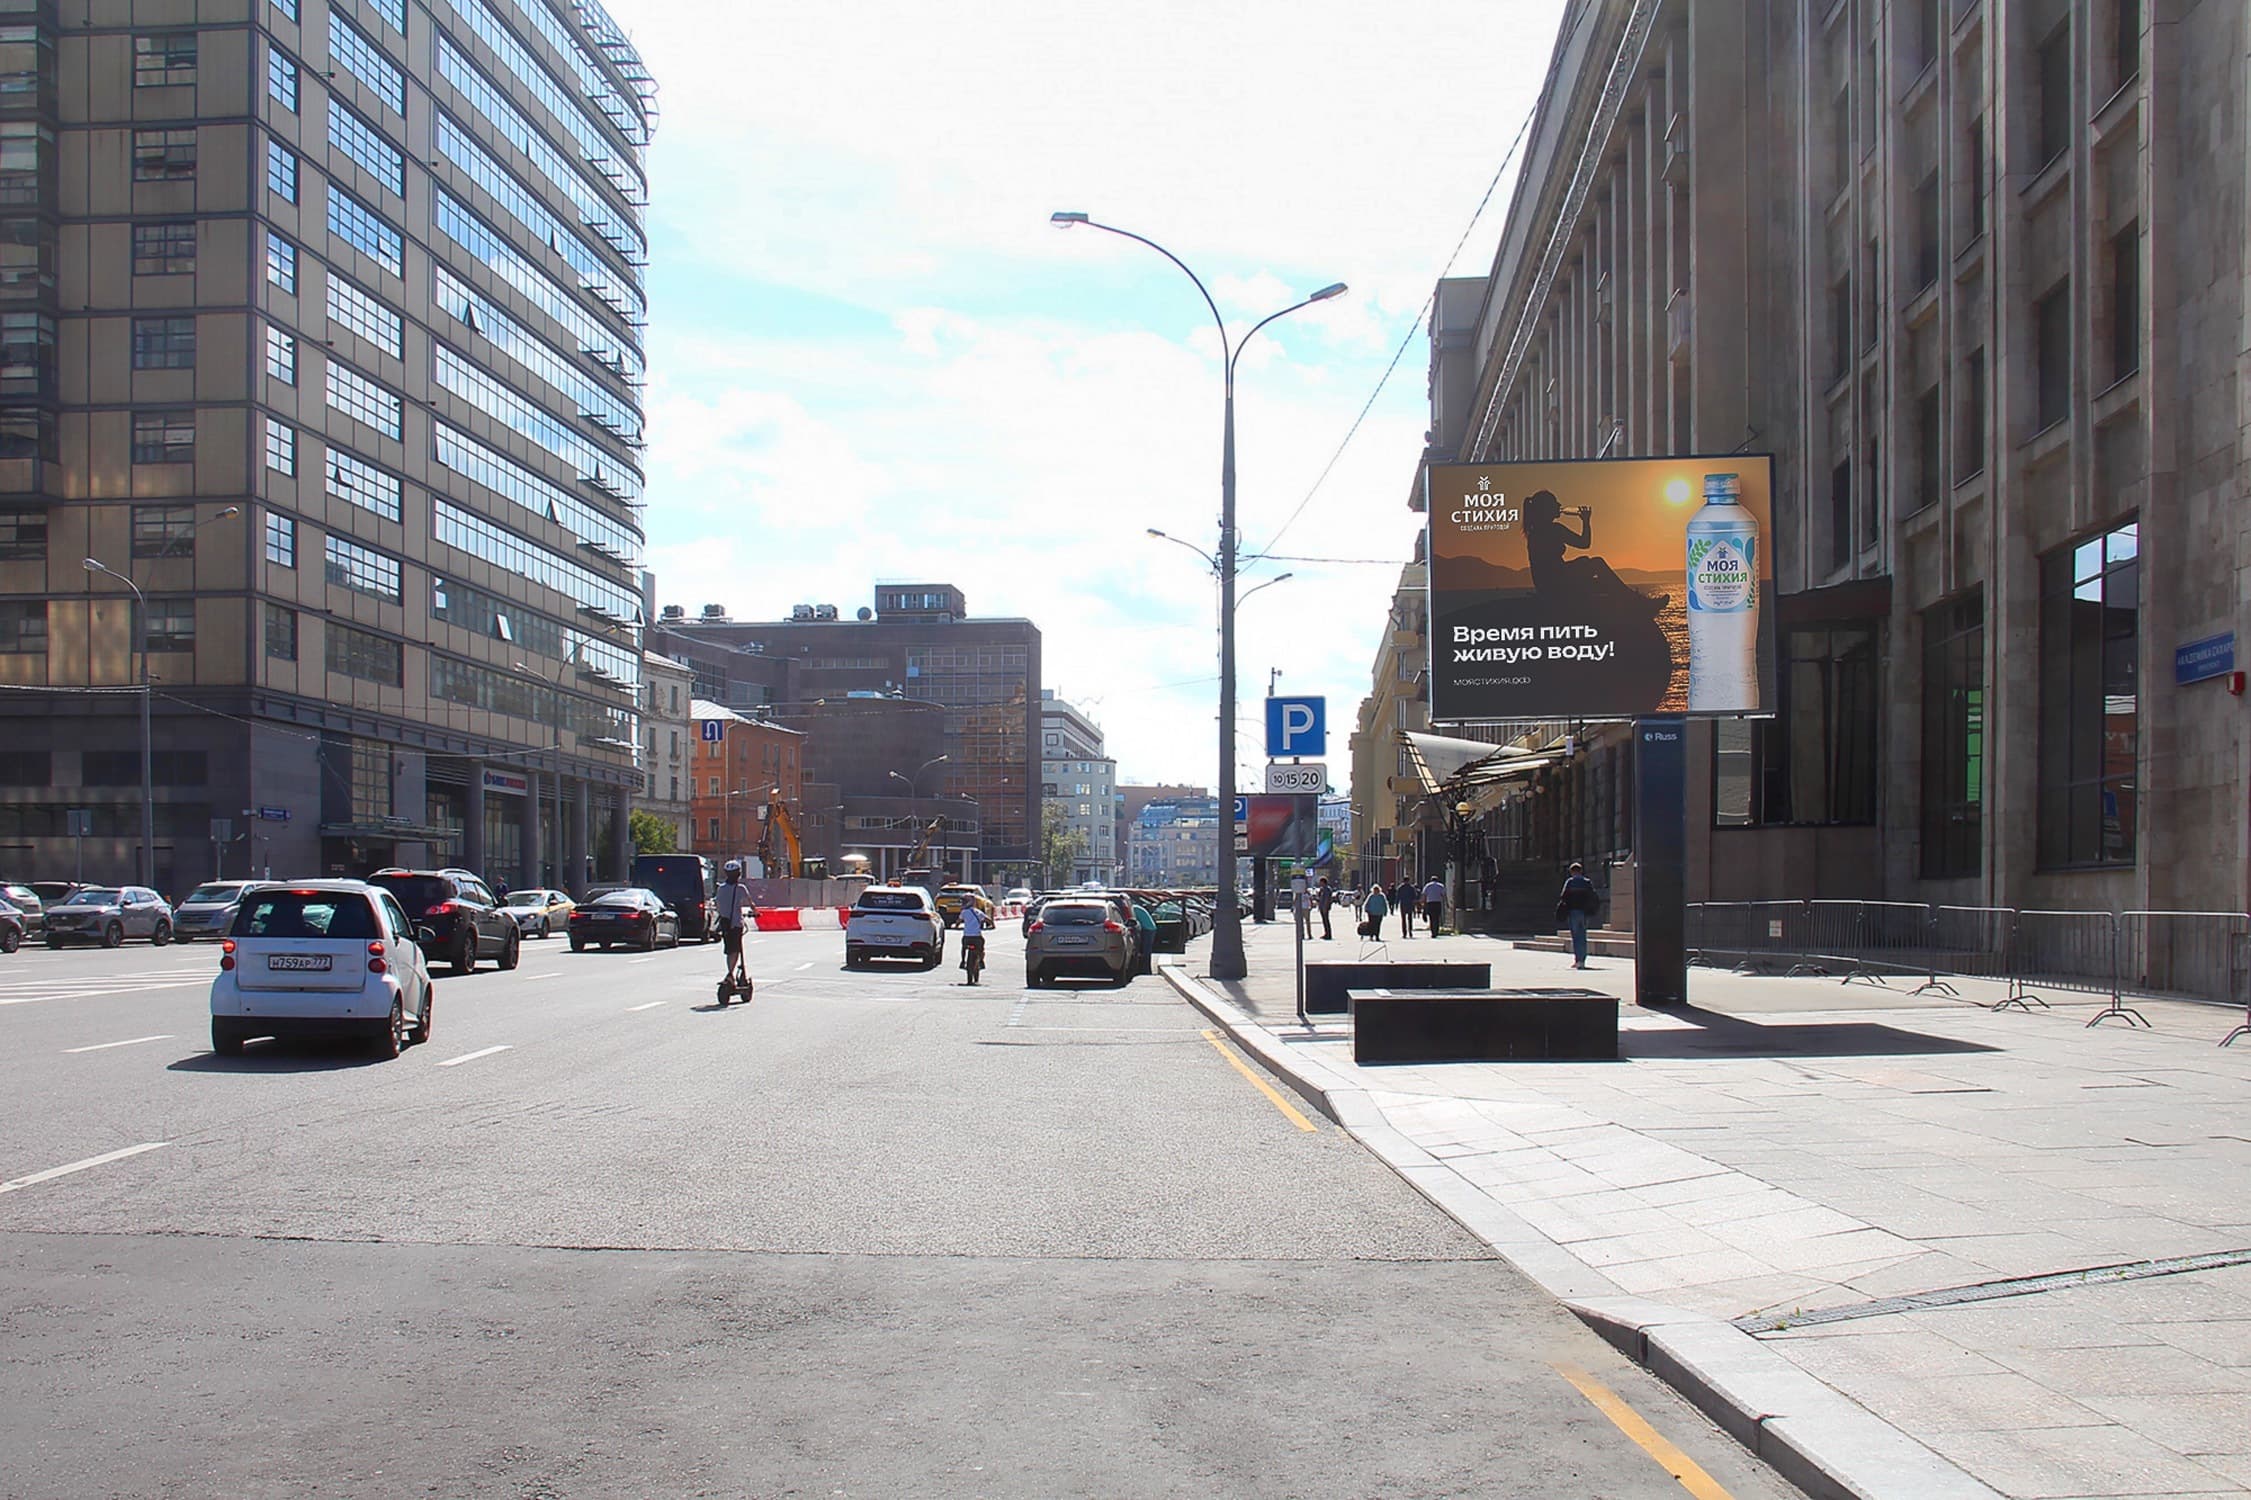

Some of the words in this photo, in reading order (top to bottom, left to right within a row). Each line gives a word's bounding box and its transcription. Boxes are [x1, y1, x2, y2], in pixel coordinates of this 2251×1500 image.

[1464, 493, 1505, 507] МОЯ
[1451, 509, 1519, 523] СТИХИЯ
[1707, 560, 1738, 572] МОЯ
[1698, 572, 1747, 583] СТИХИЯ
[1453, 626, 1534, 645] Время
[1540, 625, 1598, 640] пить
[1453, 646, 1542, 663] живую
[1547, 641, 1614, 661] воду!
[1282, 704, 1315, 750] P
[1655, 732, 1678, 741] Russ
[1273, 775, 1283, 784] 10
[1286, 773, 1298, 785] 15
[1302, 772, 1319, 785] 20
